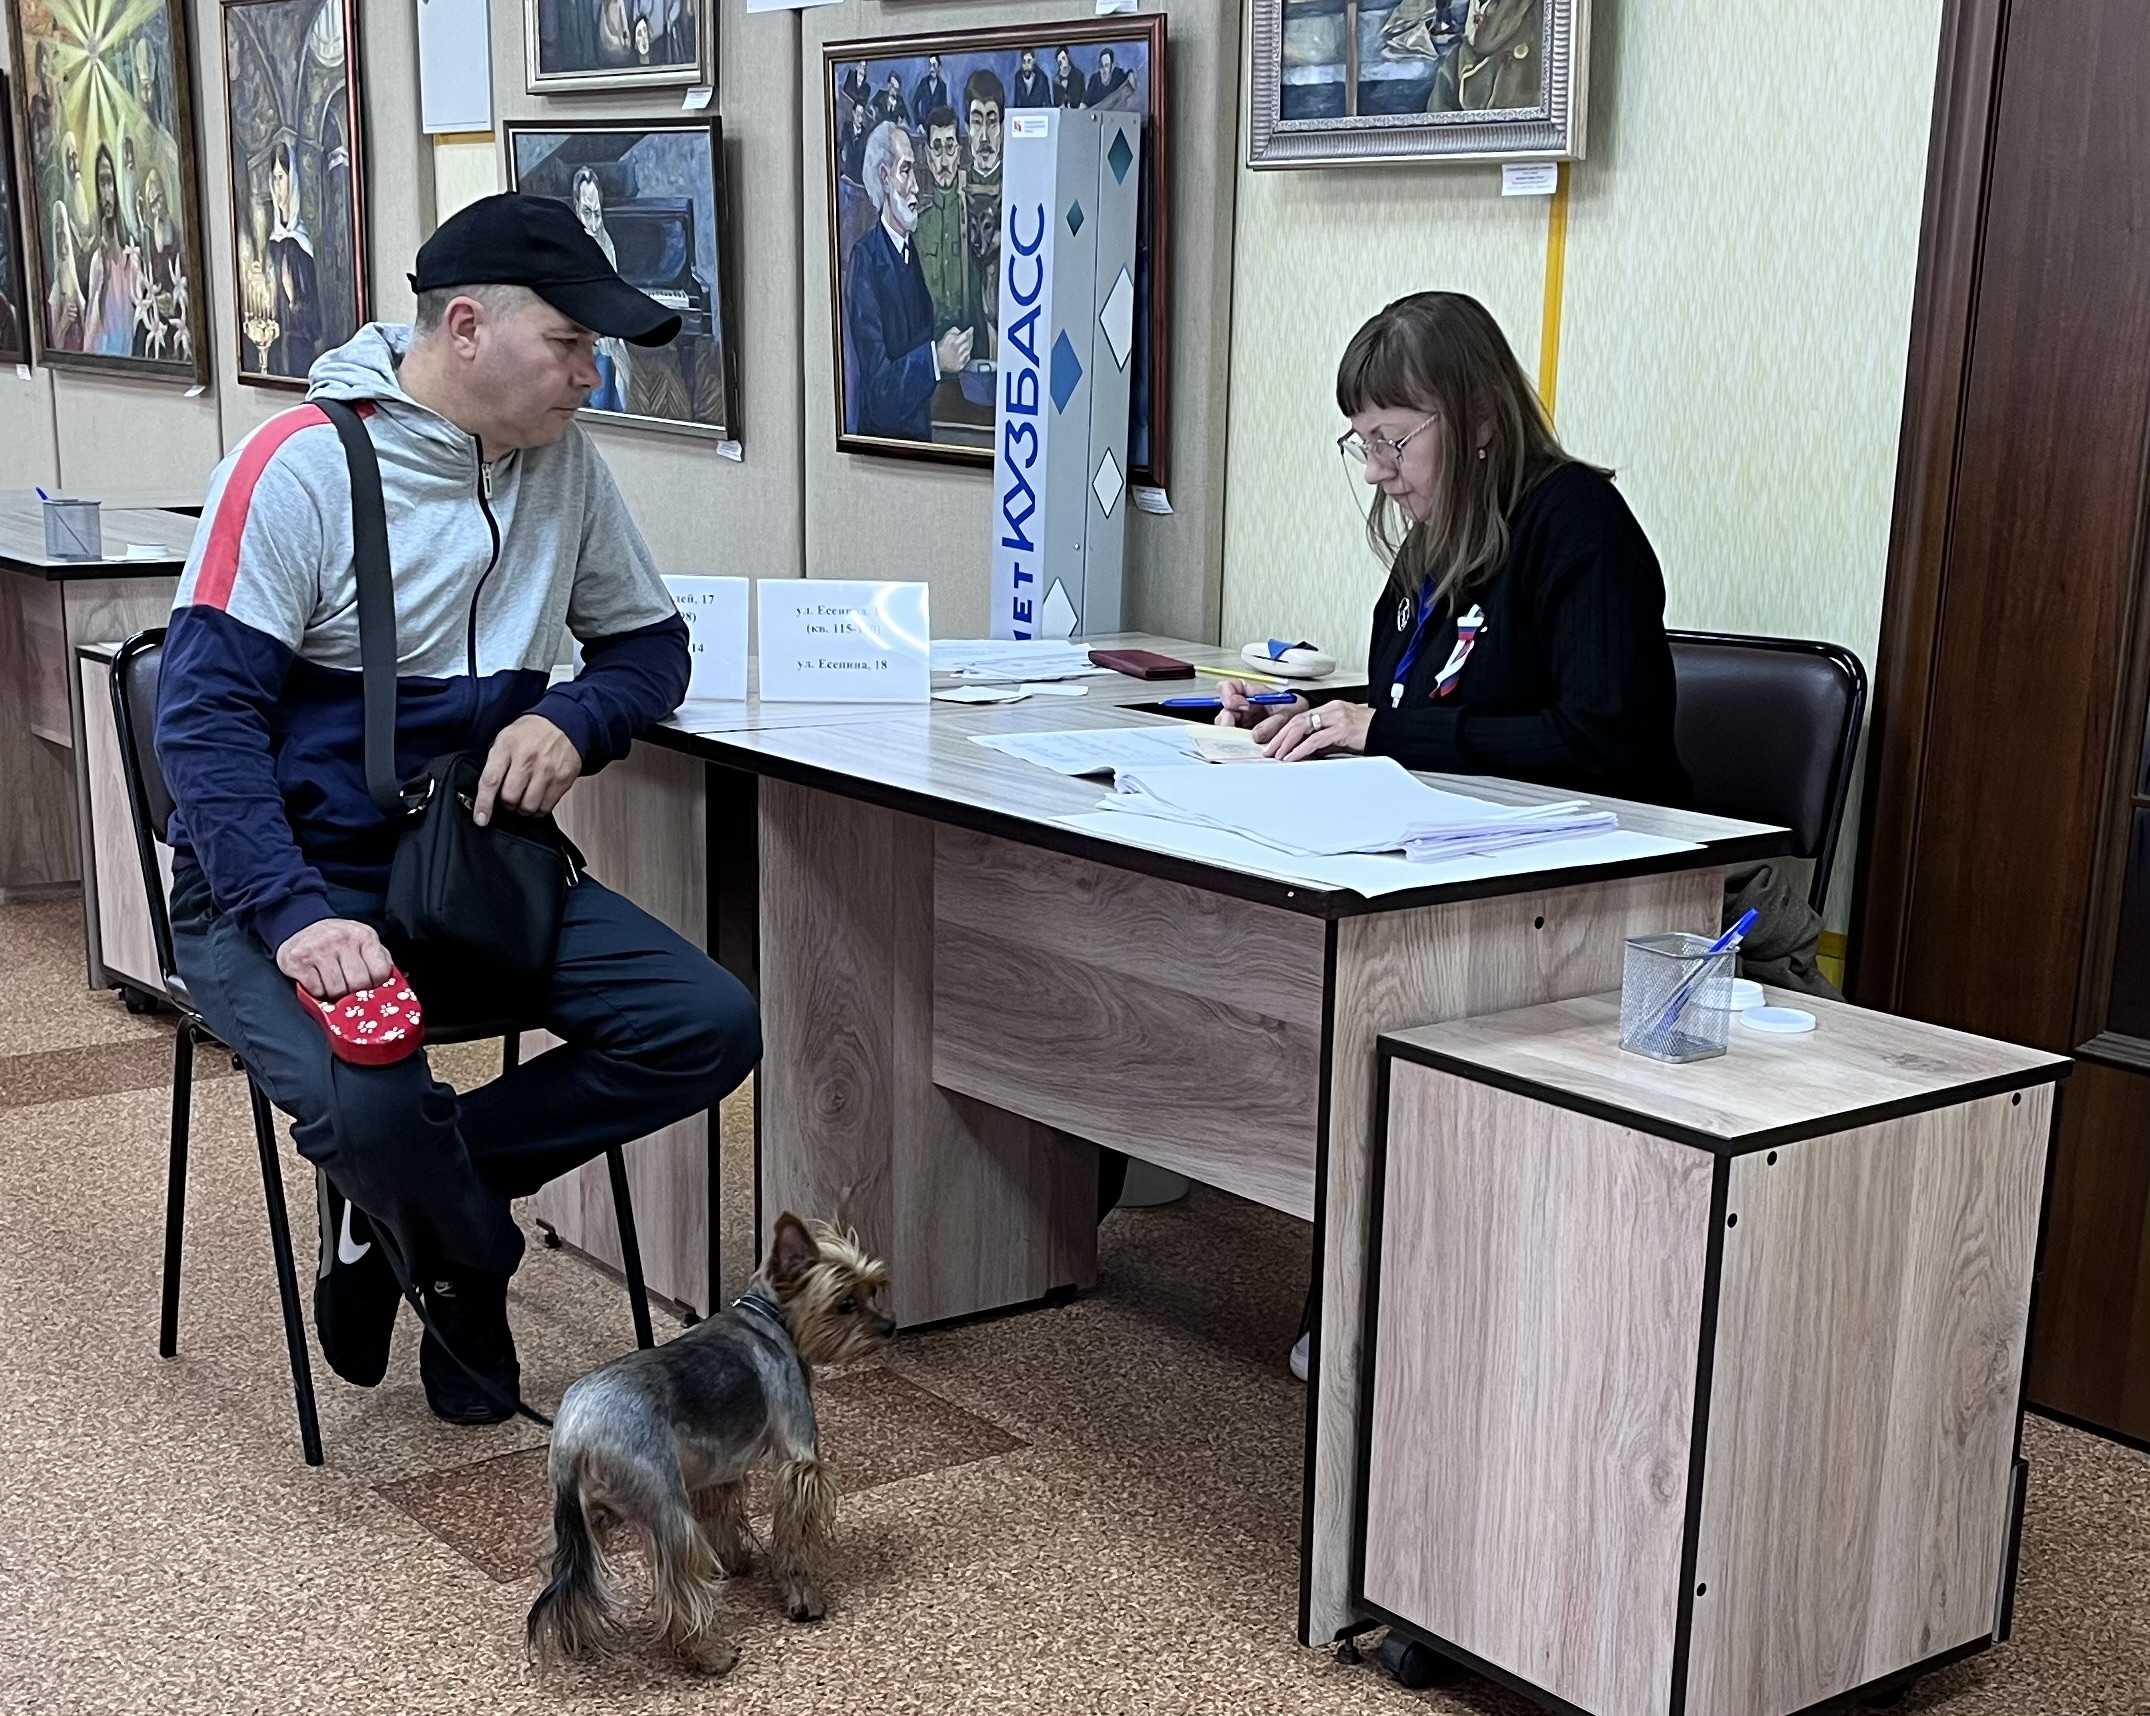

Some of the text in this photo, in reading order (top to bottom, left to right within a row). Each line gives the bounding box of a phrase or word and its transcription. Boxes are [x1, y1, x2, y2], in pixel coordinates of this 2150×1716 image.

[1002, 203, 1046, 552] КУЗБАСС
[702, 594, 715, 605] 17
[796, 607, 814, 618] ул.
[806, 623, 829, 636] (кв.
[692, 643, 704, 653] 14
[797, 659, 888, 671] ул. Есенина, 18
